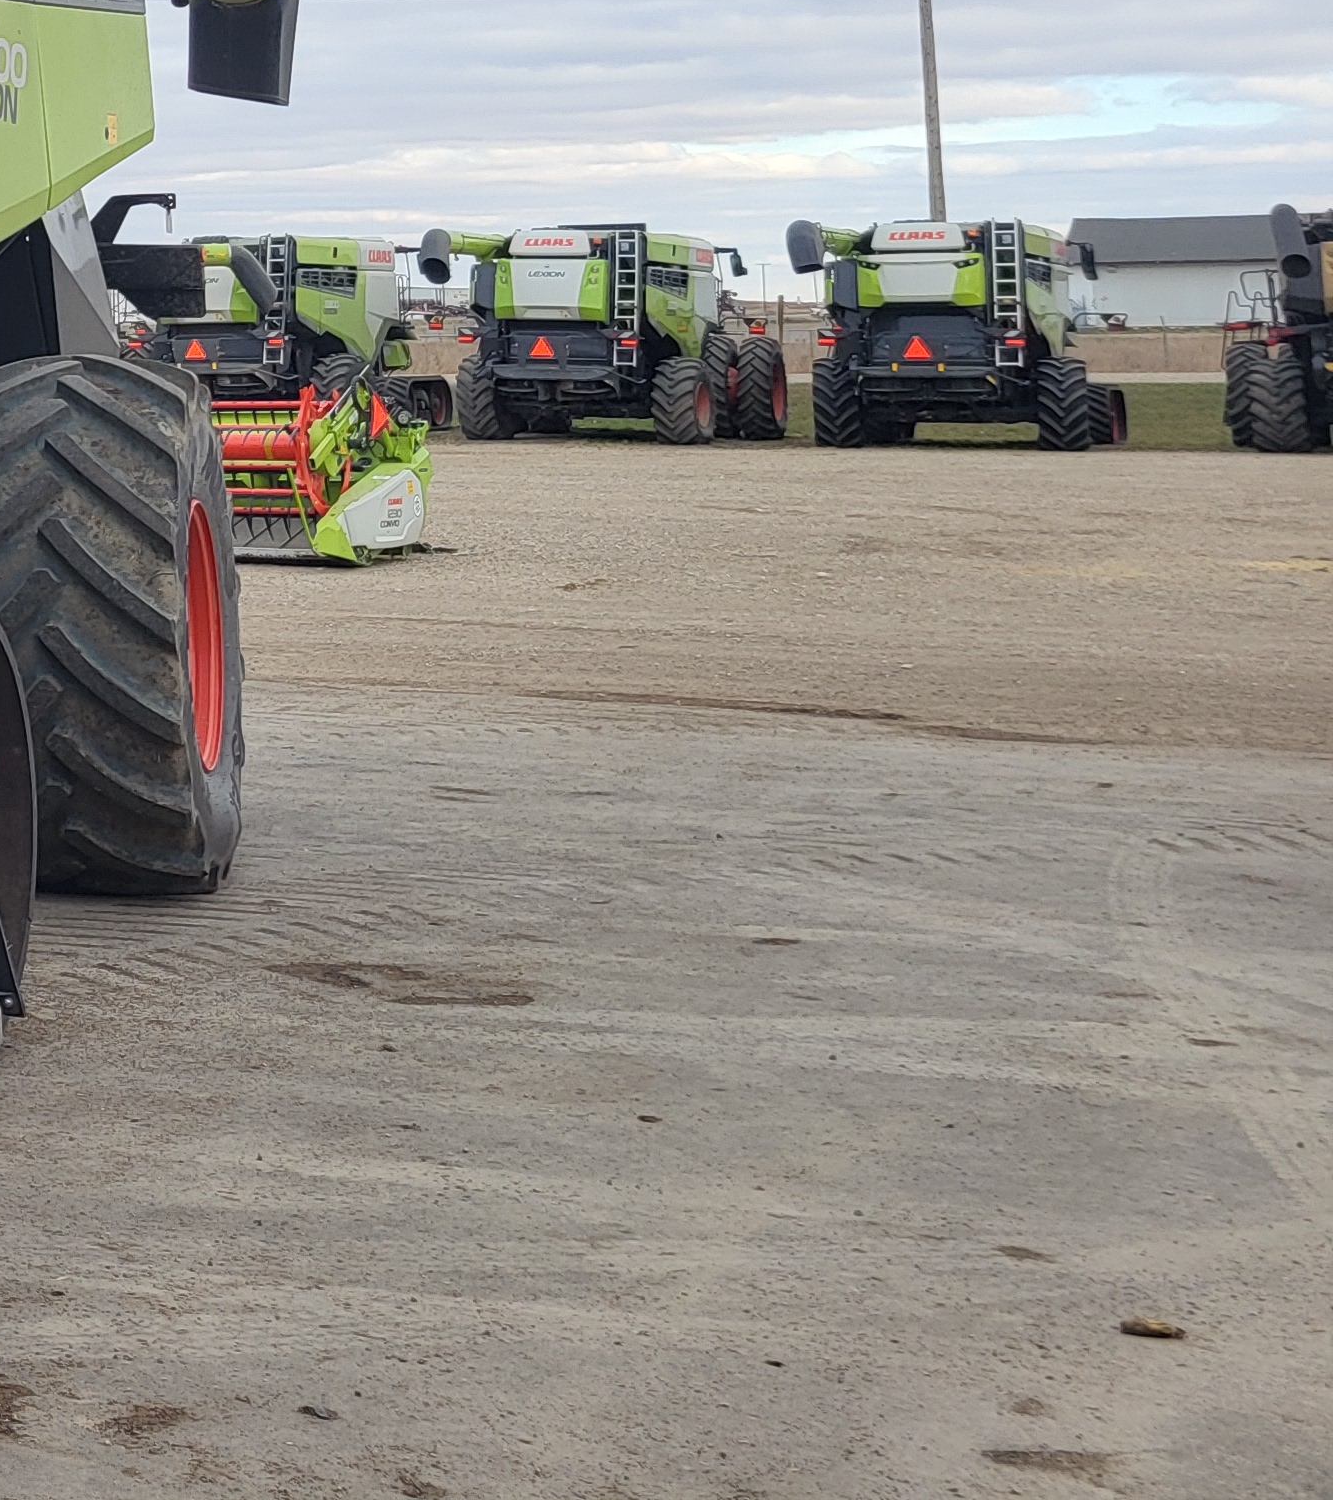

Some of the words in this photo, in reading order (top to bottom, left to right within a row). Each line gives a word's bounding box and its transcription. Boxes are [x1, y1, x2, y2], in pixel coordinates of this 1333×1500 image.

[889, 231, 946, 241] CLAAS
[524, 238, 574, 246] CLAAS
[368, 249, 392, 263] CLAAS
